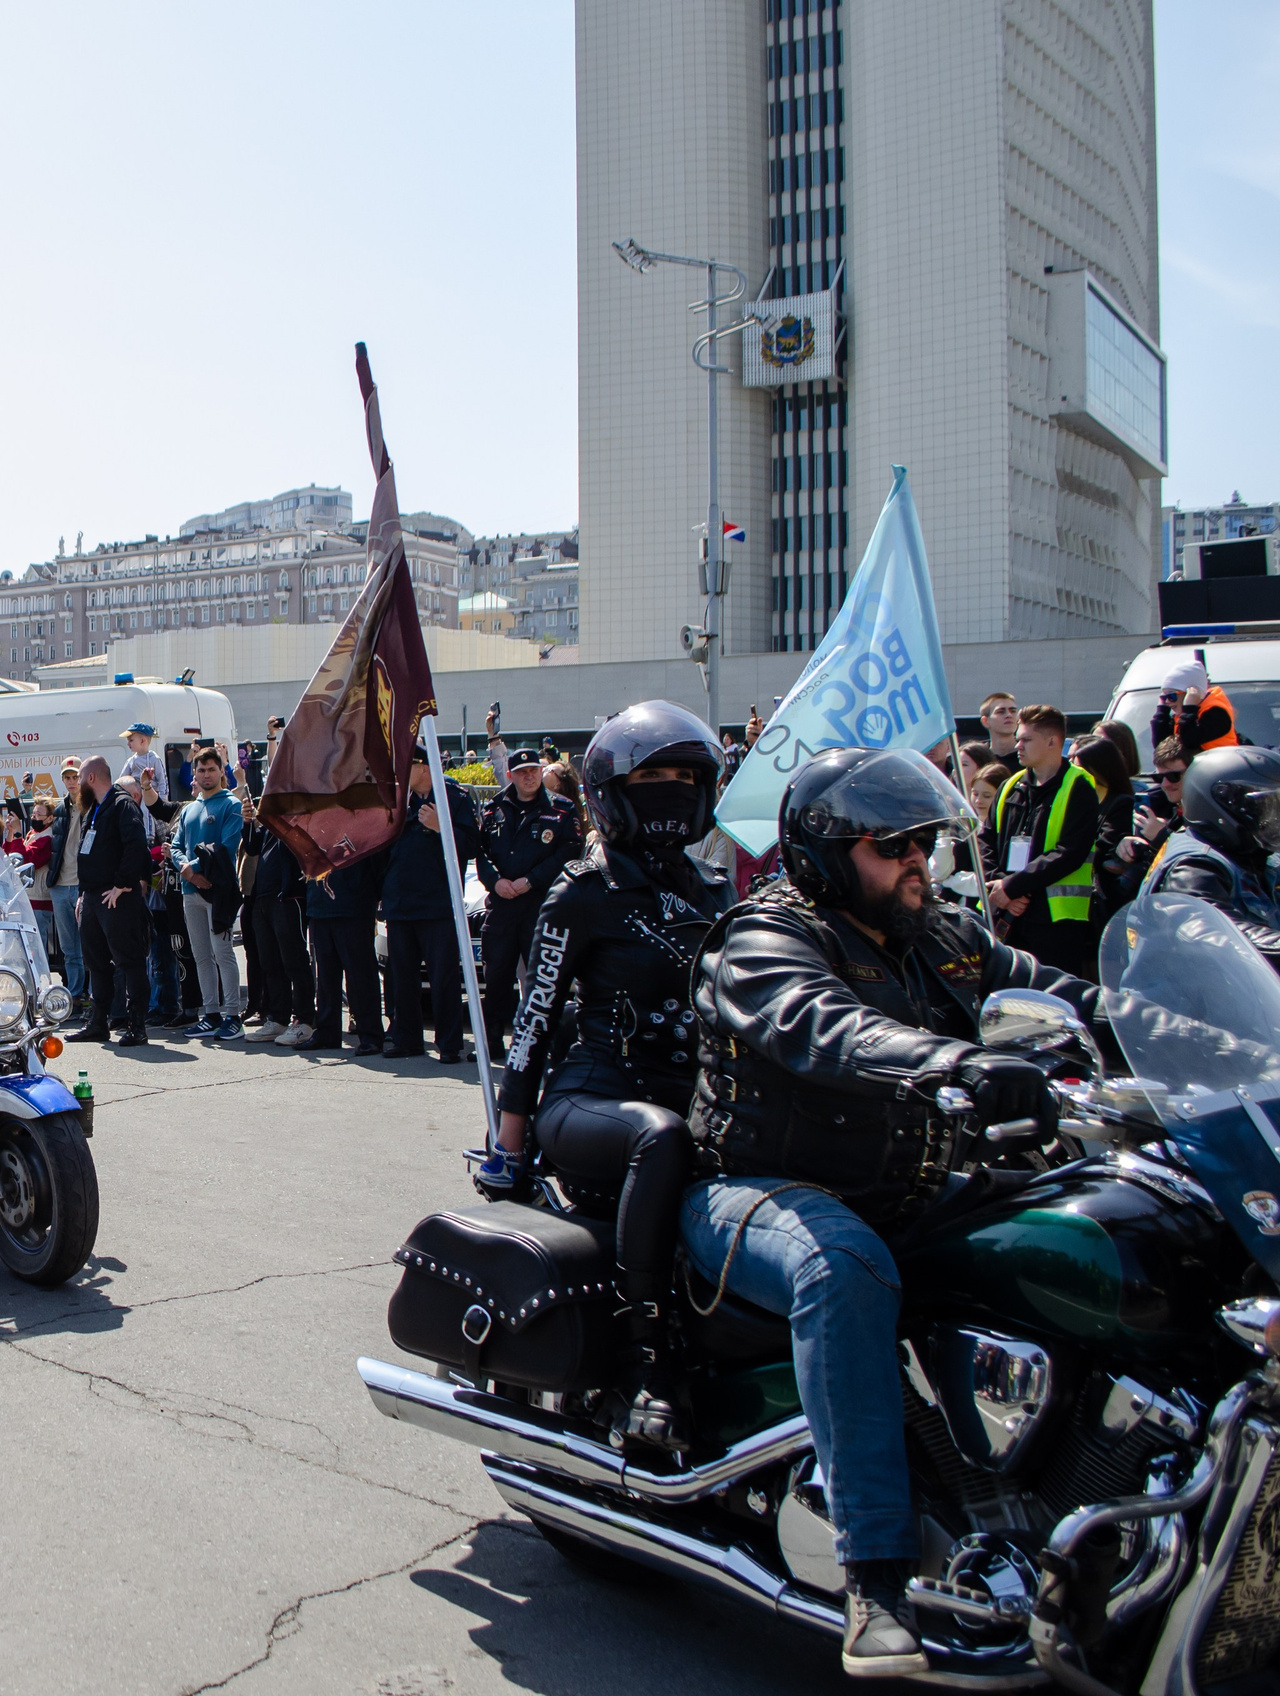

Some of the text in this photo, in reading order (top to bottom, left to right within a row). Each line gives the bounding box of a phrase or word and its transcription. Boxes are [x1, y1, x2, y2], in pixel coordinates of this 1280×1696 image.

[22, 733, 40, 742] 103
[26, 754, 81, 768] ИНСУЛ
[523, 922, 570, 1032] STRUGGLE
